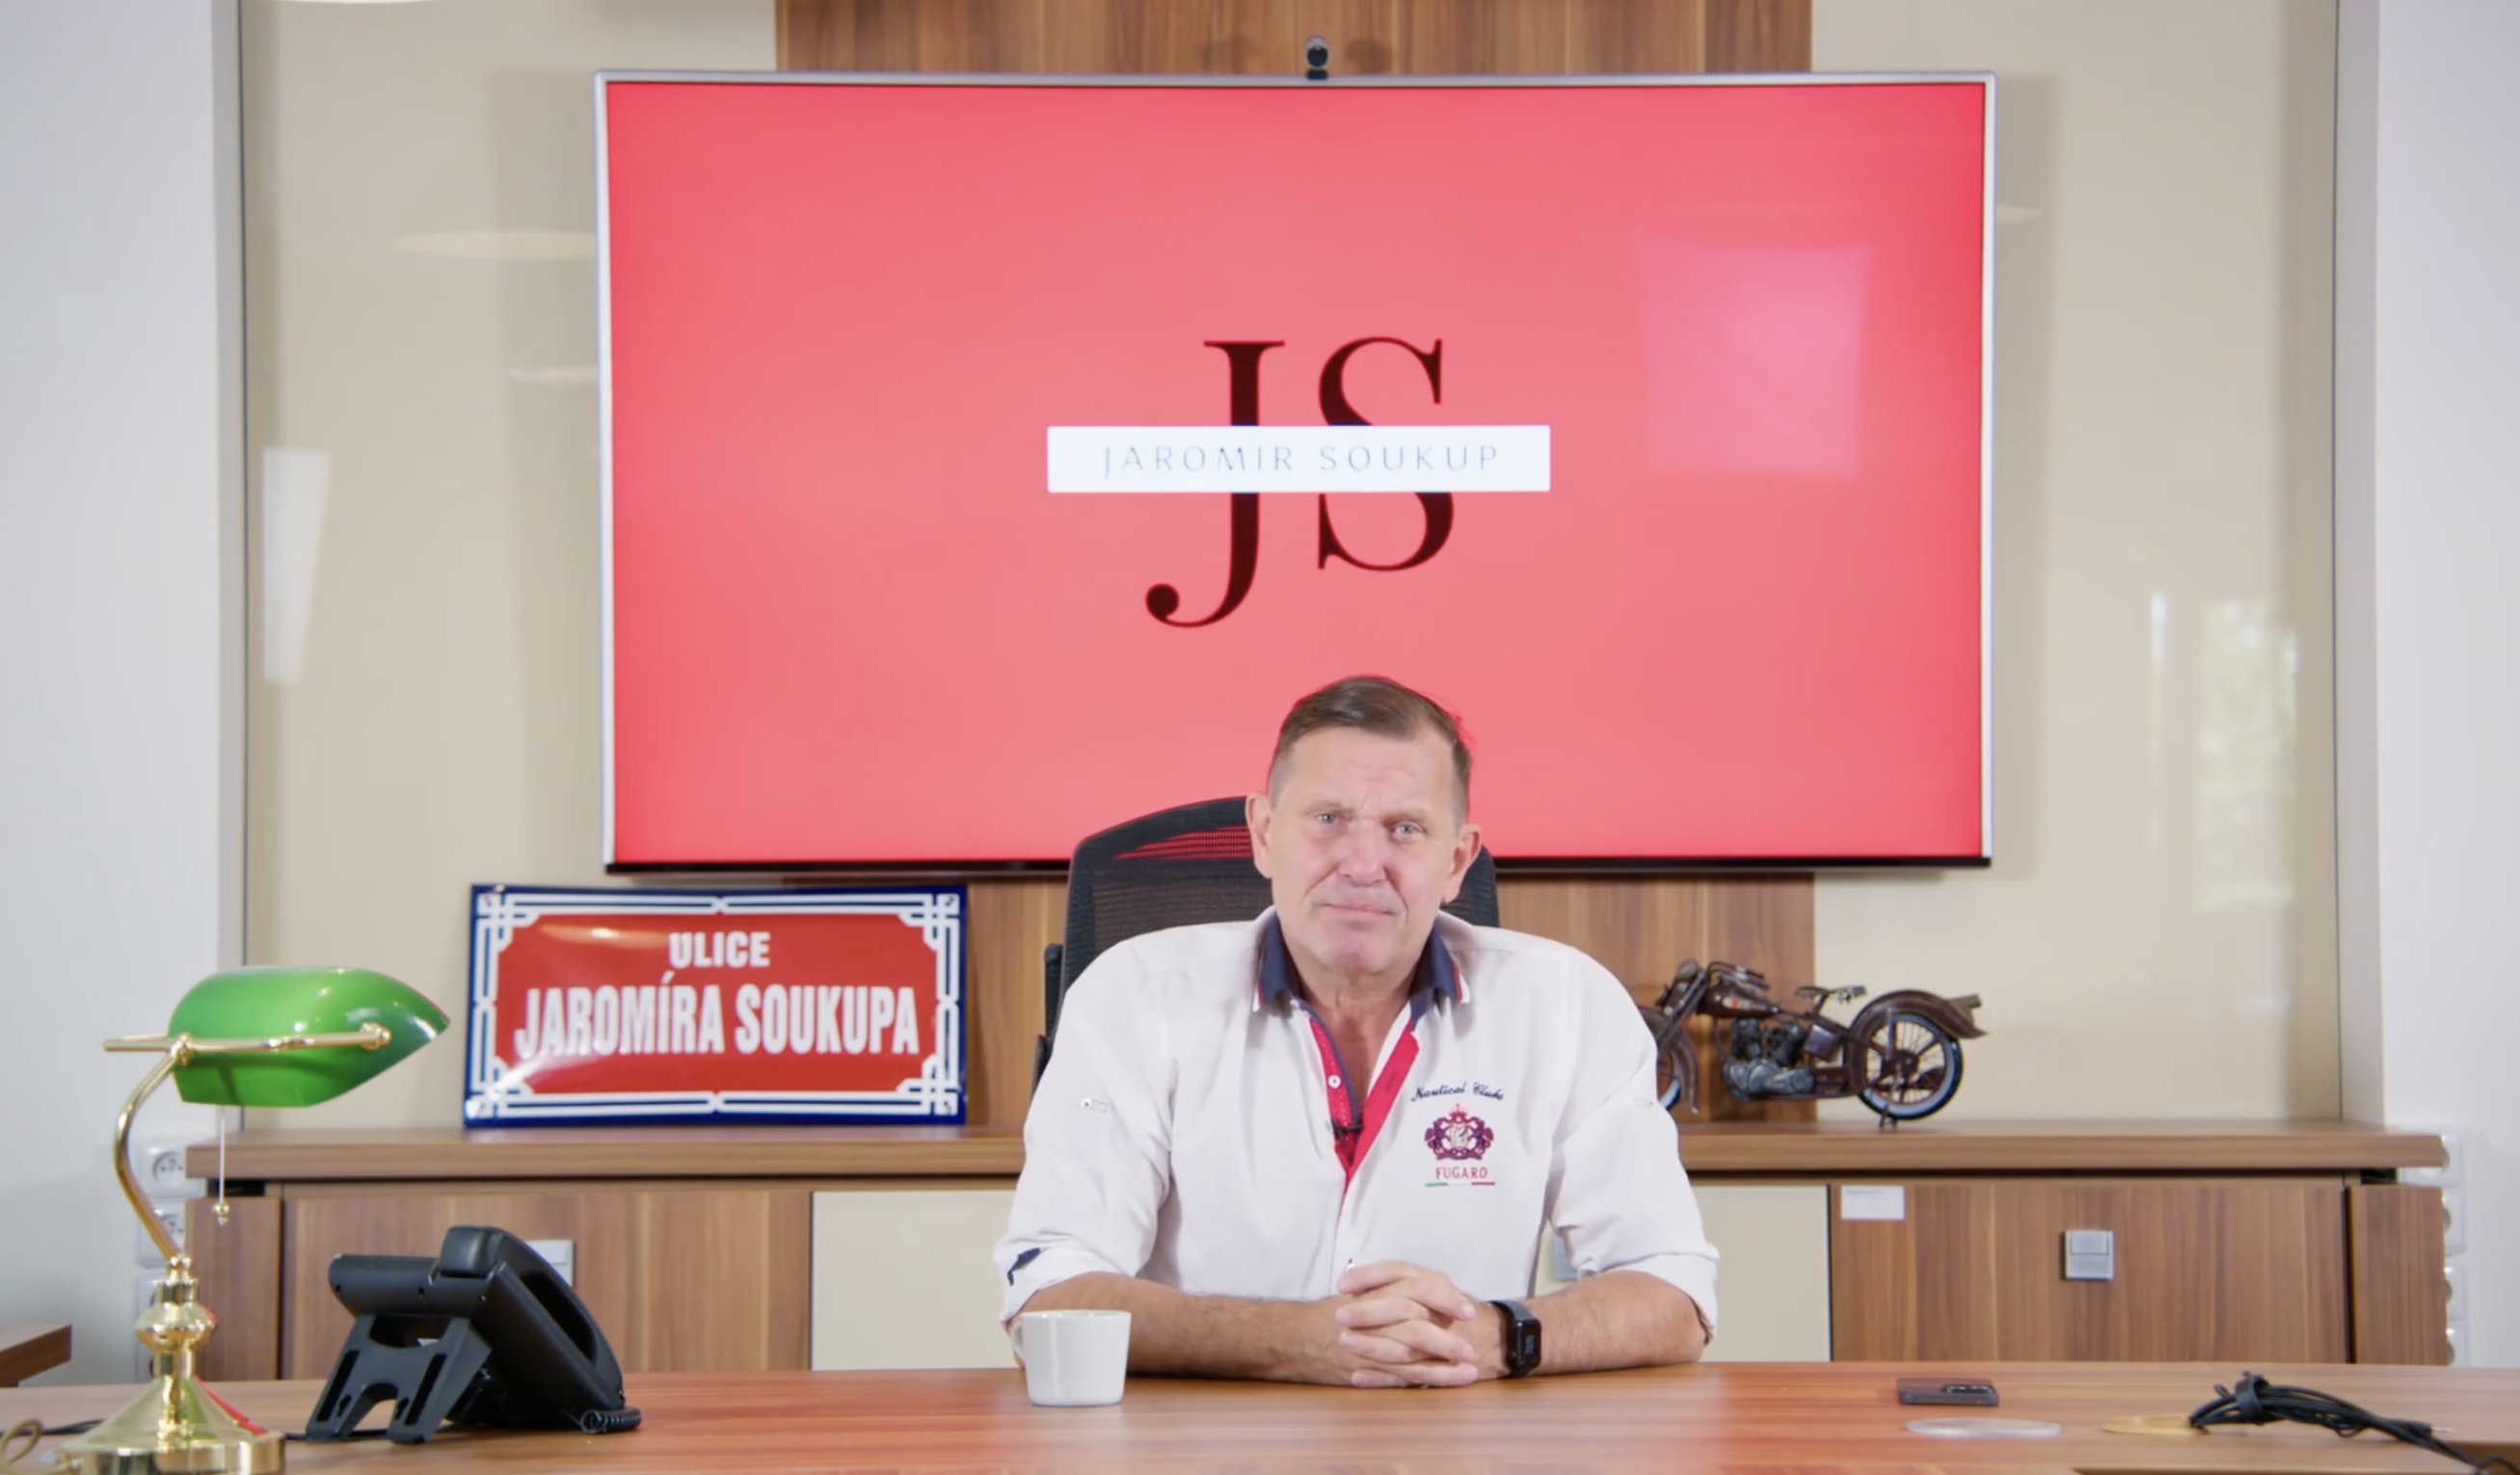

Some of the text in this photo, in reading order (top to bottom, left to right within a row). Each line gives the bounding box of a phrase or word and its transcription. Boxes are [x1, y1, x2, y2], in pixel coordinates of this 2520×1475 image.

[1102, 444, 1499, 478] JAROMIR SOUKUP
[1145, 336, 1454, 628] JS
[668, 931, 771, 969] ULICE
[513, 971, 921, 1059] JAROMÍRA SOUKUPA
[1411, 1081, 1467, 1102] Nautical
[1435, 1167, 1488, 1179] FUGARO
